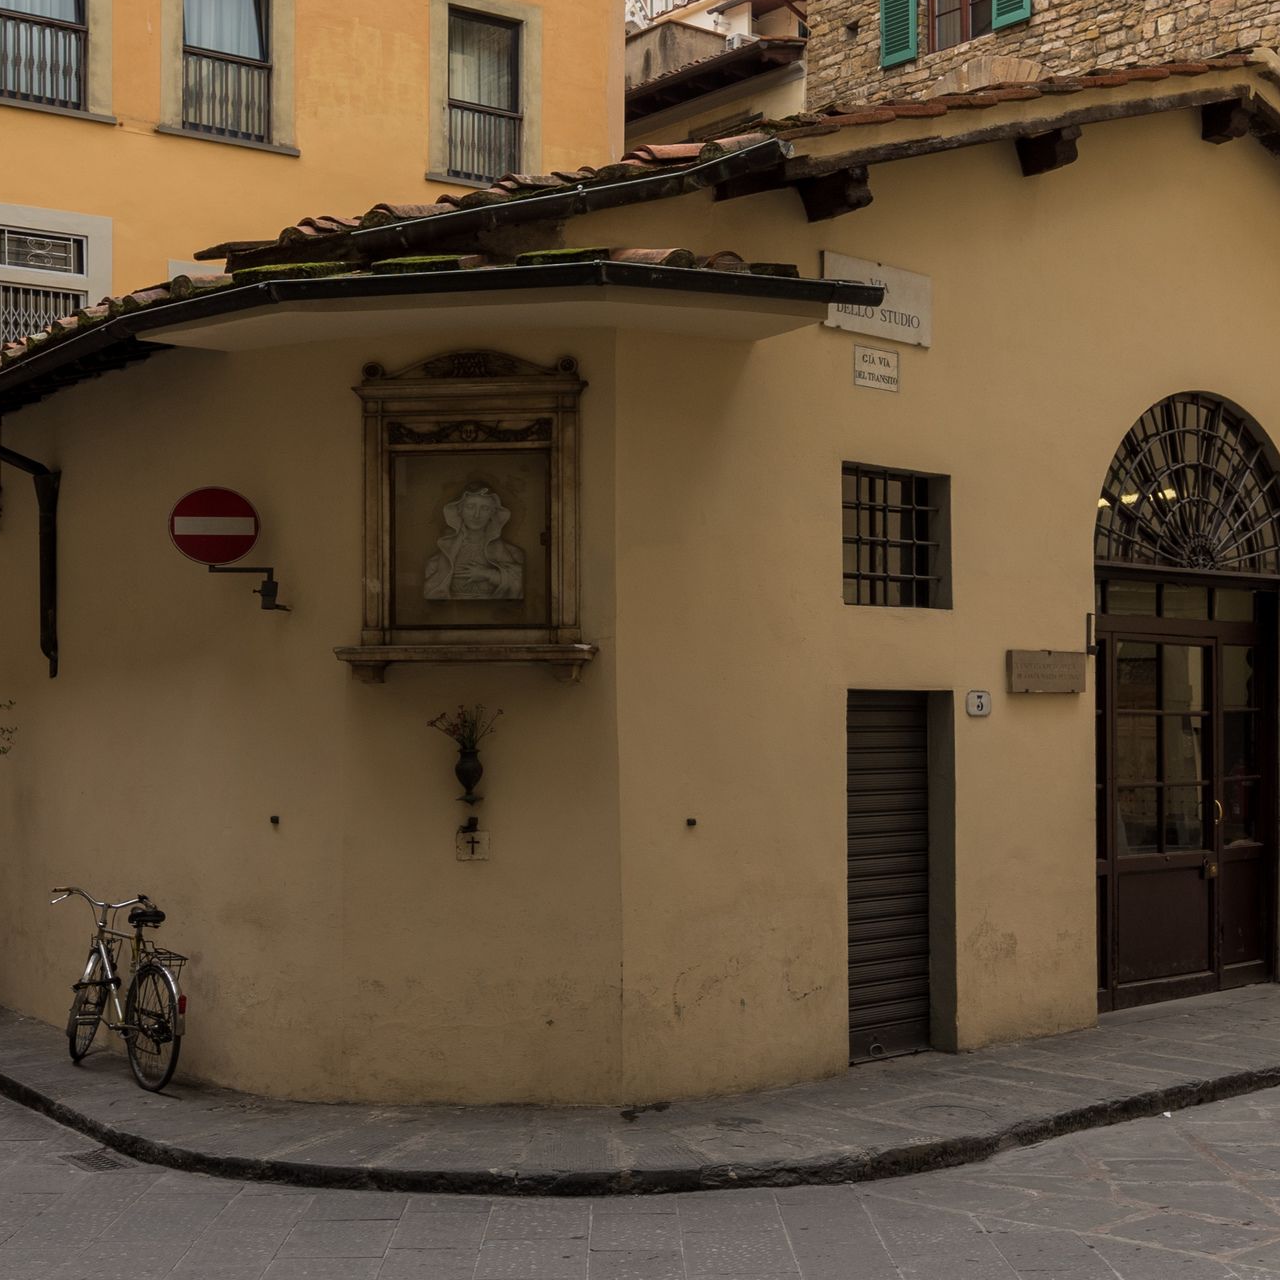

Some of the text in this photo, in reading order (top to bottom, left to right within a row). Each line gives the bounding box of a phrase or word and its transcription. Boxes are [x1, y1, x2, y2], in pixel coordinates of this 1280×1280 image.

[836, 303, 920, 329] DELLO STUDIO
[878, 356, 891, 368] VIA
[855, 370, 898, 386] DEL TRANSITO
[976, 695, 984, 712] 3
